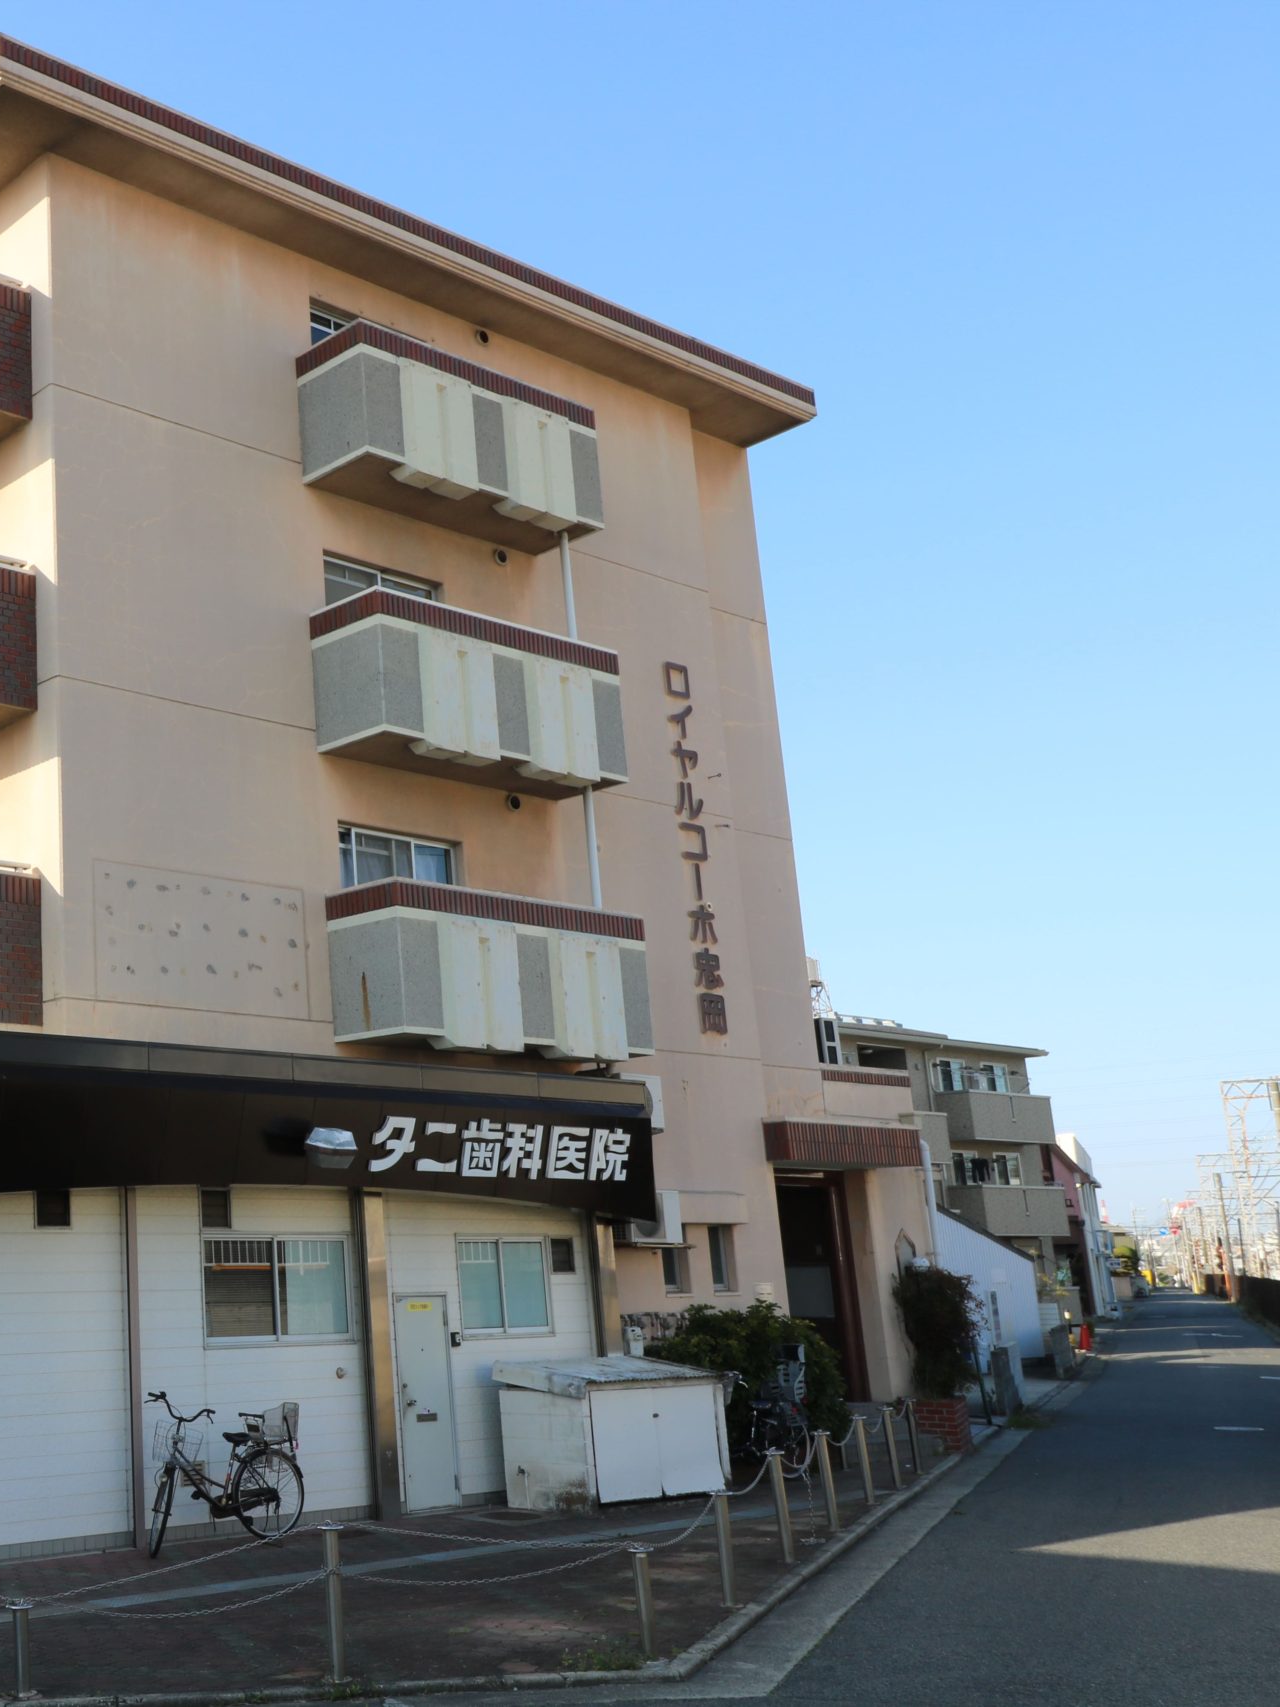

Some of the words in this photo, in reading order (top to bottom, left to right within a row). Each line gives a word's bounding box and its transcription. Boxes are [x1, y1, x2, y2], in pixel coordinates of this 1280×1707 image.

[663, 661, 728, 1035] ロイヤルコーポ忠岡
[368, 1115, 631, 1181] タニ歯科医院
